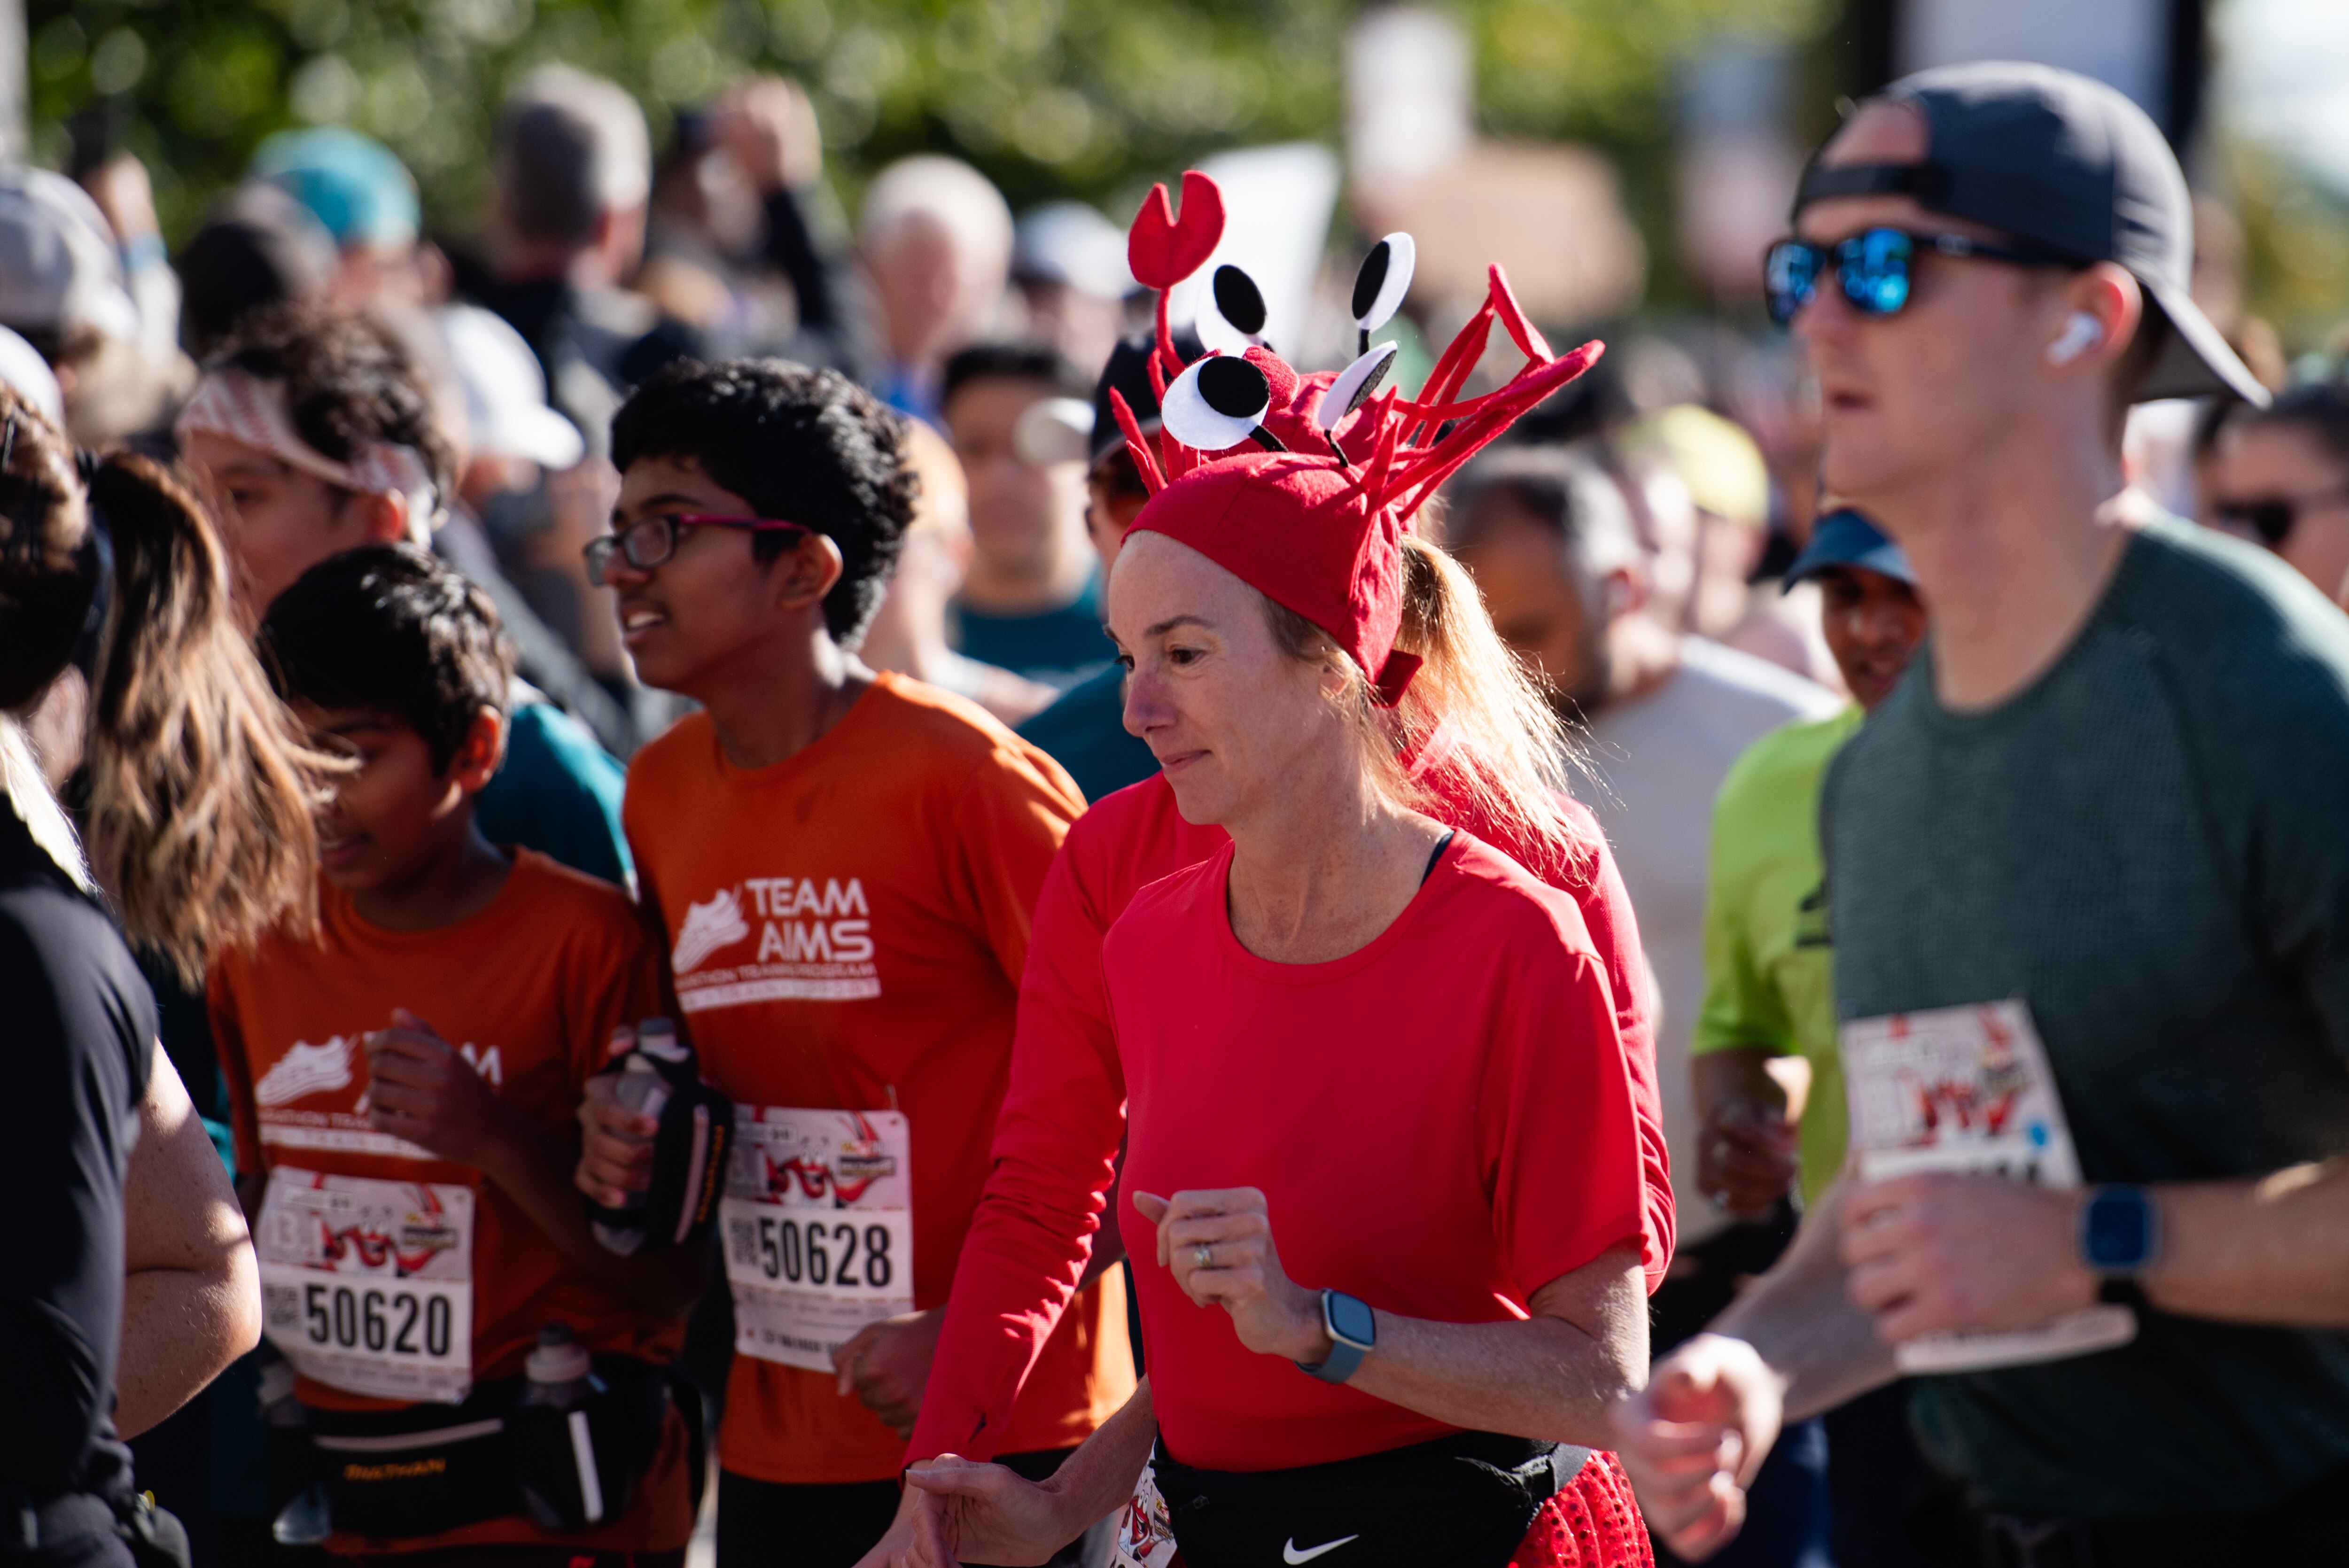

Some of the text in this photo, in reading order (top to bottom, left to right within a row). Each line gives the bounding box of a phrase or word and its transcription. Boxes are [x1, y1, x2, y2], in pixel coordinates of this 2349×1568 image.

[745, 877, 870, 916] TEAM
[757, 919, 875, 962] AIMS
[759, 1217, 891, 1288] 50628
[306, 1284, 451, 1356] 50620
